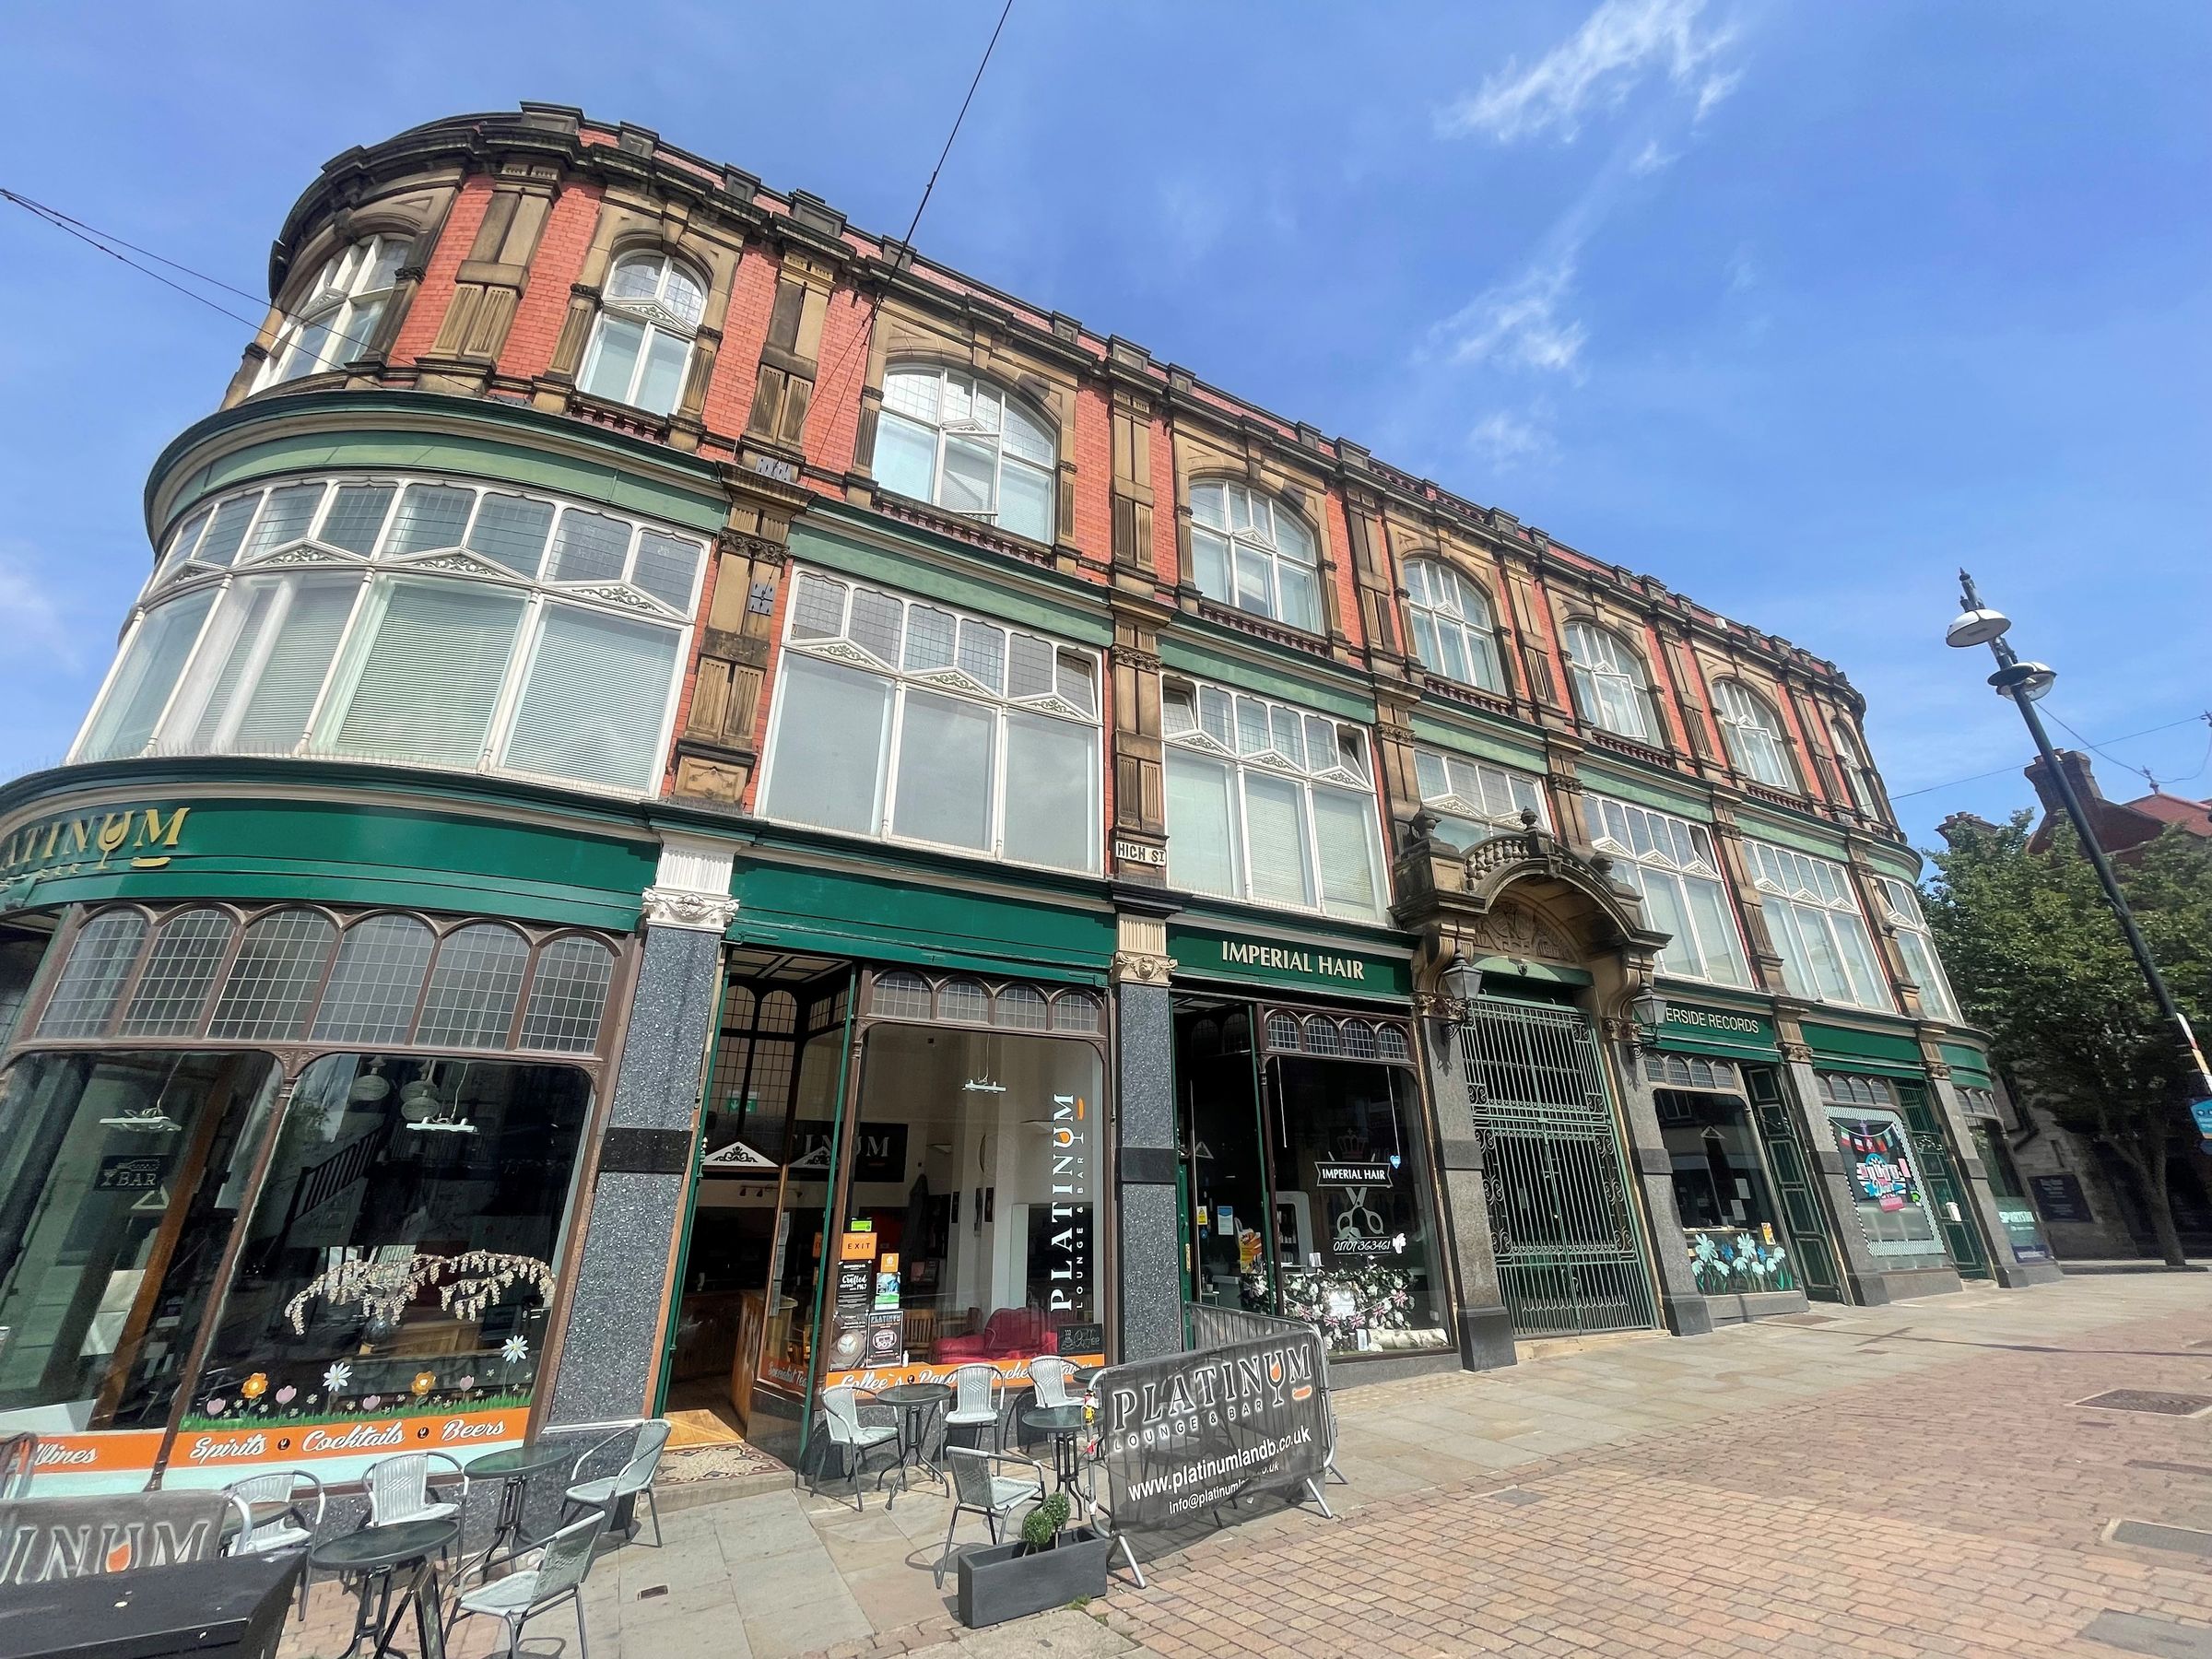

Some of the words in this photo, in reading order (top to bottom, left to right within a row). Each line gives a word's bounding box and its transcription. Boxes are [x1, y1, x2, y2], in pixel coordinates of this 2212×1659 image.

[1117, 842, 1147, 861] HIGH
[1222, 941, 1312, 972] IMPERIAL
[1318, 955, 1365, 980] HAIR
[1665, 1007, 1707, 1027] ERSIDE
[1708, 1014, 1759, 1034] RECORDS
[116, 1171, 157, 1186] BAR
[1076, 1157, 1085, 1195] BAR
[1322, 1169, 1363, 1180] IMPERIAL
[1364, 1170, 1386, 1180] HAIR
[1050, 1093, 1084, 1312] PLATINUM
[1076, 1227, 1085, 1309] LOUNGE
[1112, 1345, 1312, 1431] PLATINUM
[189, 1434, 267, 1465] Spirits
[301, 1422, 406, 1453] Cocktails
[441, 1419, 507, 1441] Beers
[1113, 1417, 1198, 1452] LOUNGE
[1209, 1411, 1218, 1424] &
[1229, 1399, 1263, 1420] BAR
[1128, 1424, 1312, 1501] www.platinumlandb.co.uk
